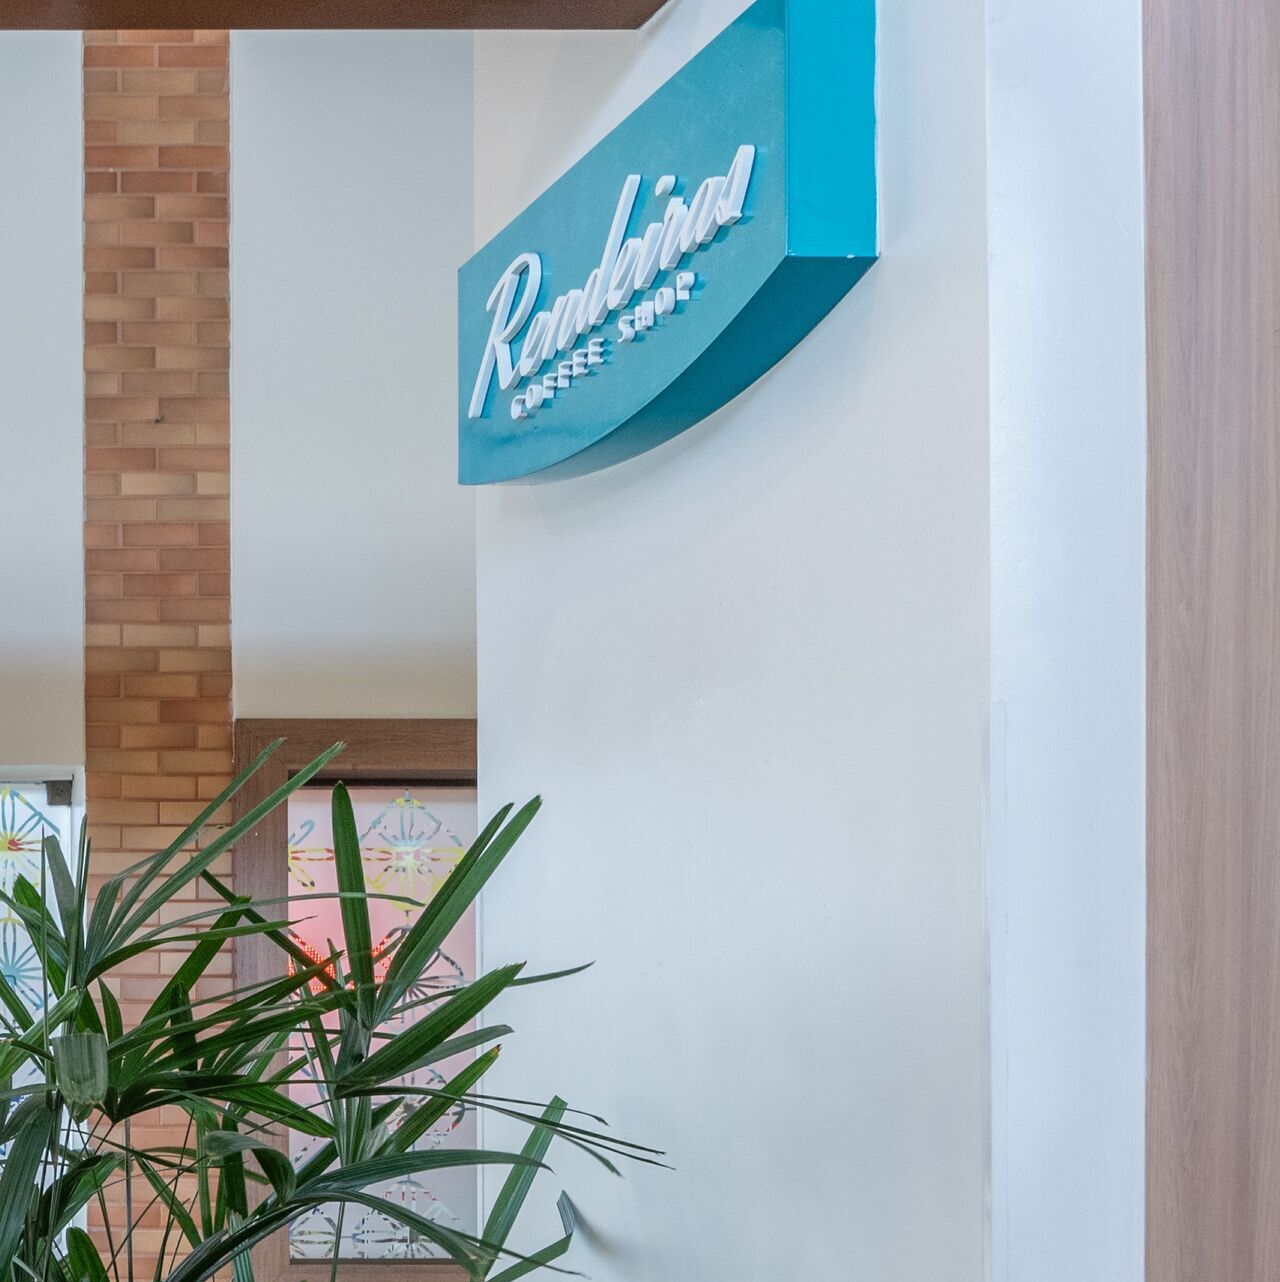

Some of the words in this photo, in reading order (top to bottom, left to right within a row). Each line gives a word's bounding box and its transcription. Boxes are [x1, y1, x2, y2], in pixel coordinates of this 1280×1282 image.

[468, 144, 756, 418] Rendeiras
[510, 337, 605, 420] COFFEE
[617, 271, 696, 344] SHOP
